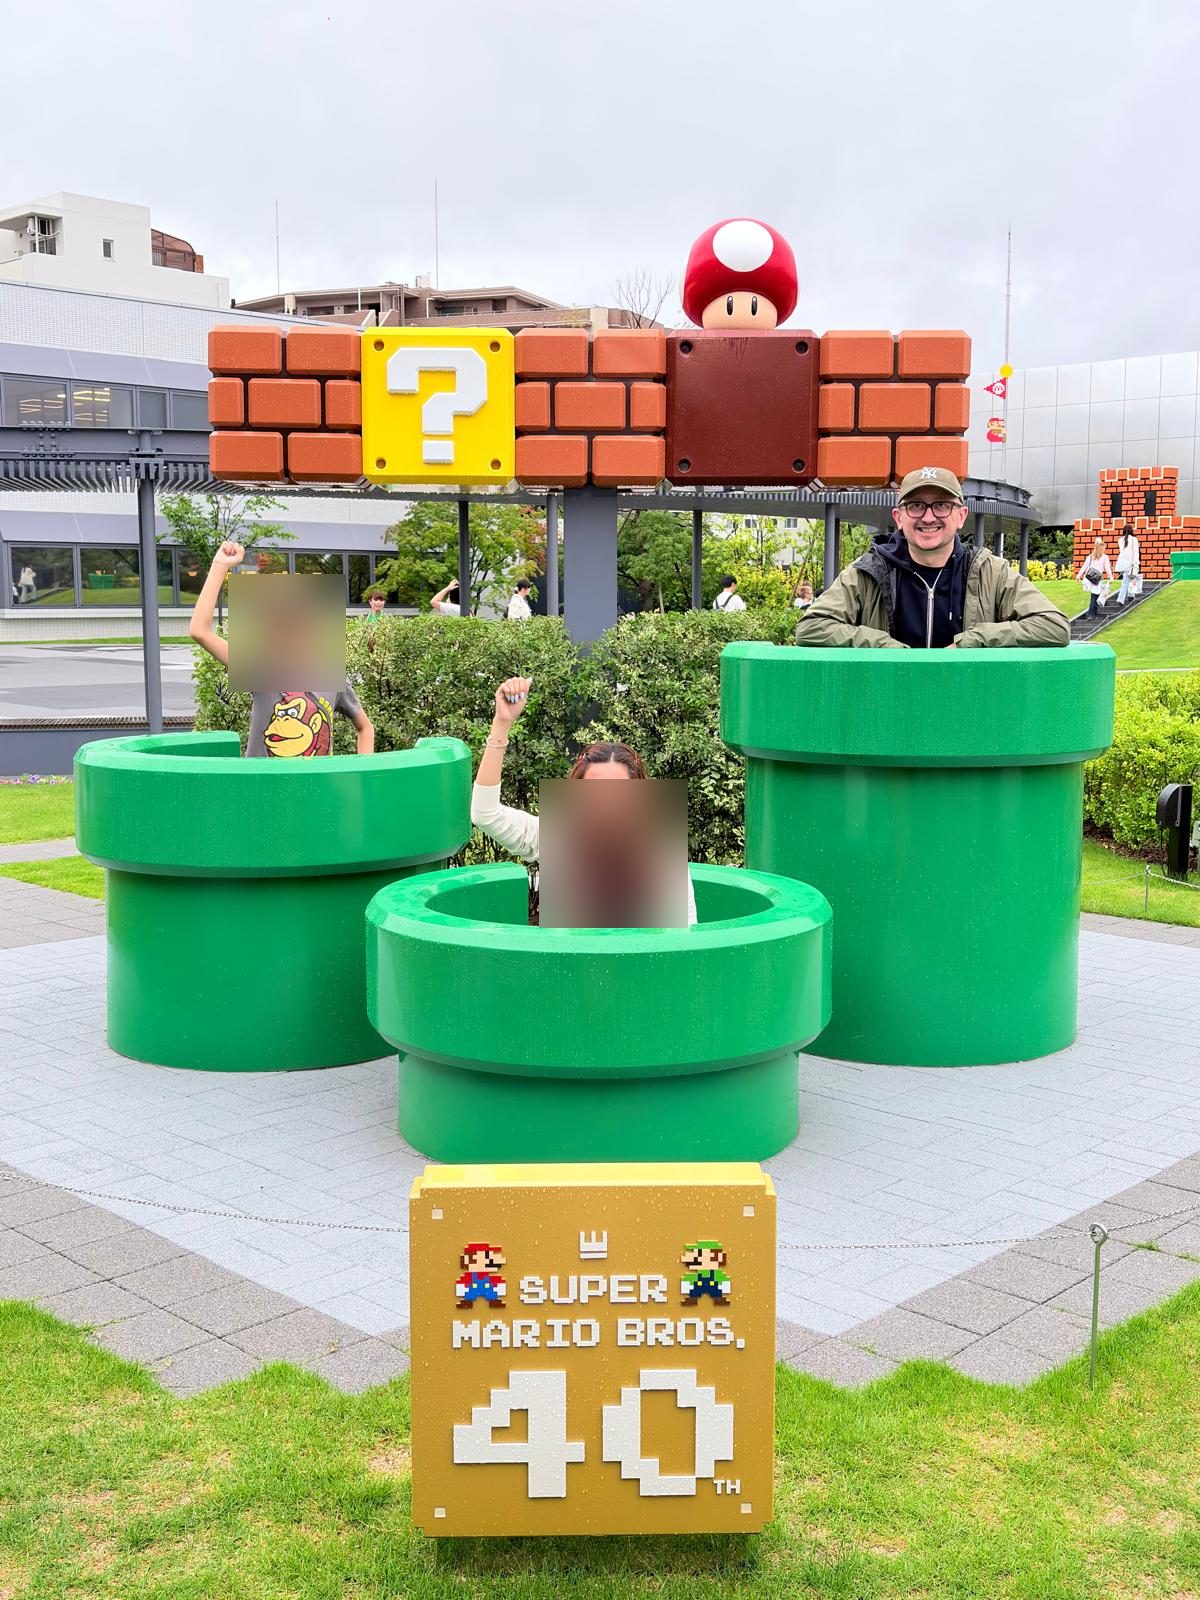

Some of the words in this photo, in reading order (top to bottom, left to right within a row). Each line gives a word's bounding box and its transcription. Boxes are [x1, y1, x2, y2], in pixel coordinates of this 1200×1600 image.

[386, 347, 488, 464] ?
[519, 1274, 668, 1305] SUPER
[452, 1318, 601, 1349] MARIO
[617, 1317, 746, 1350] BROS.
